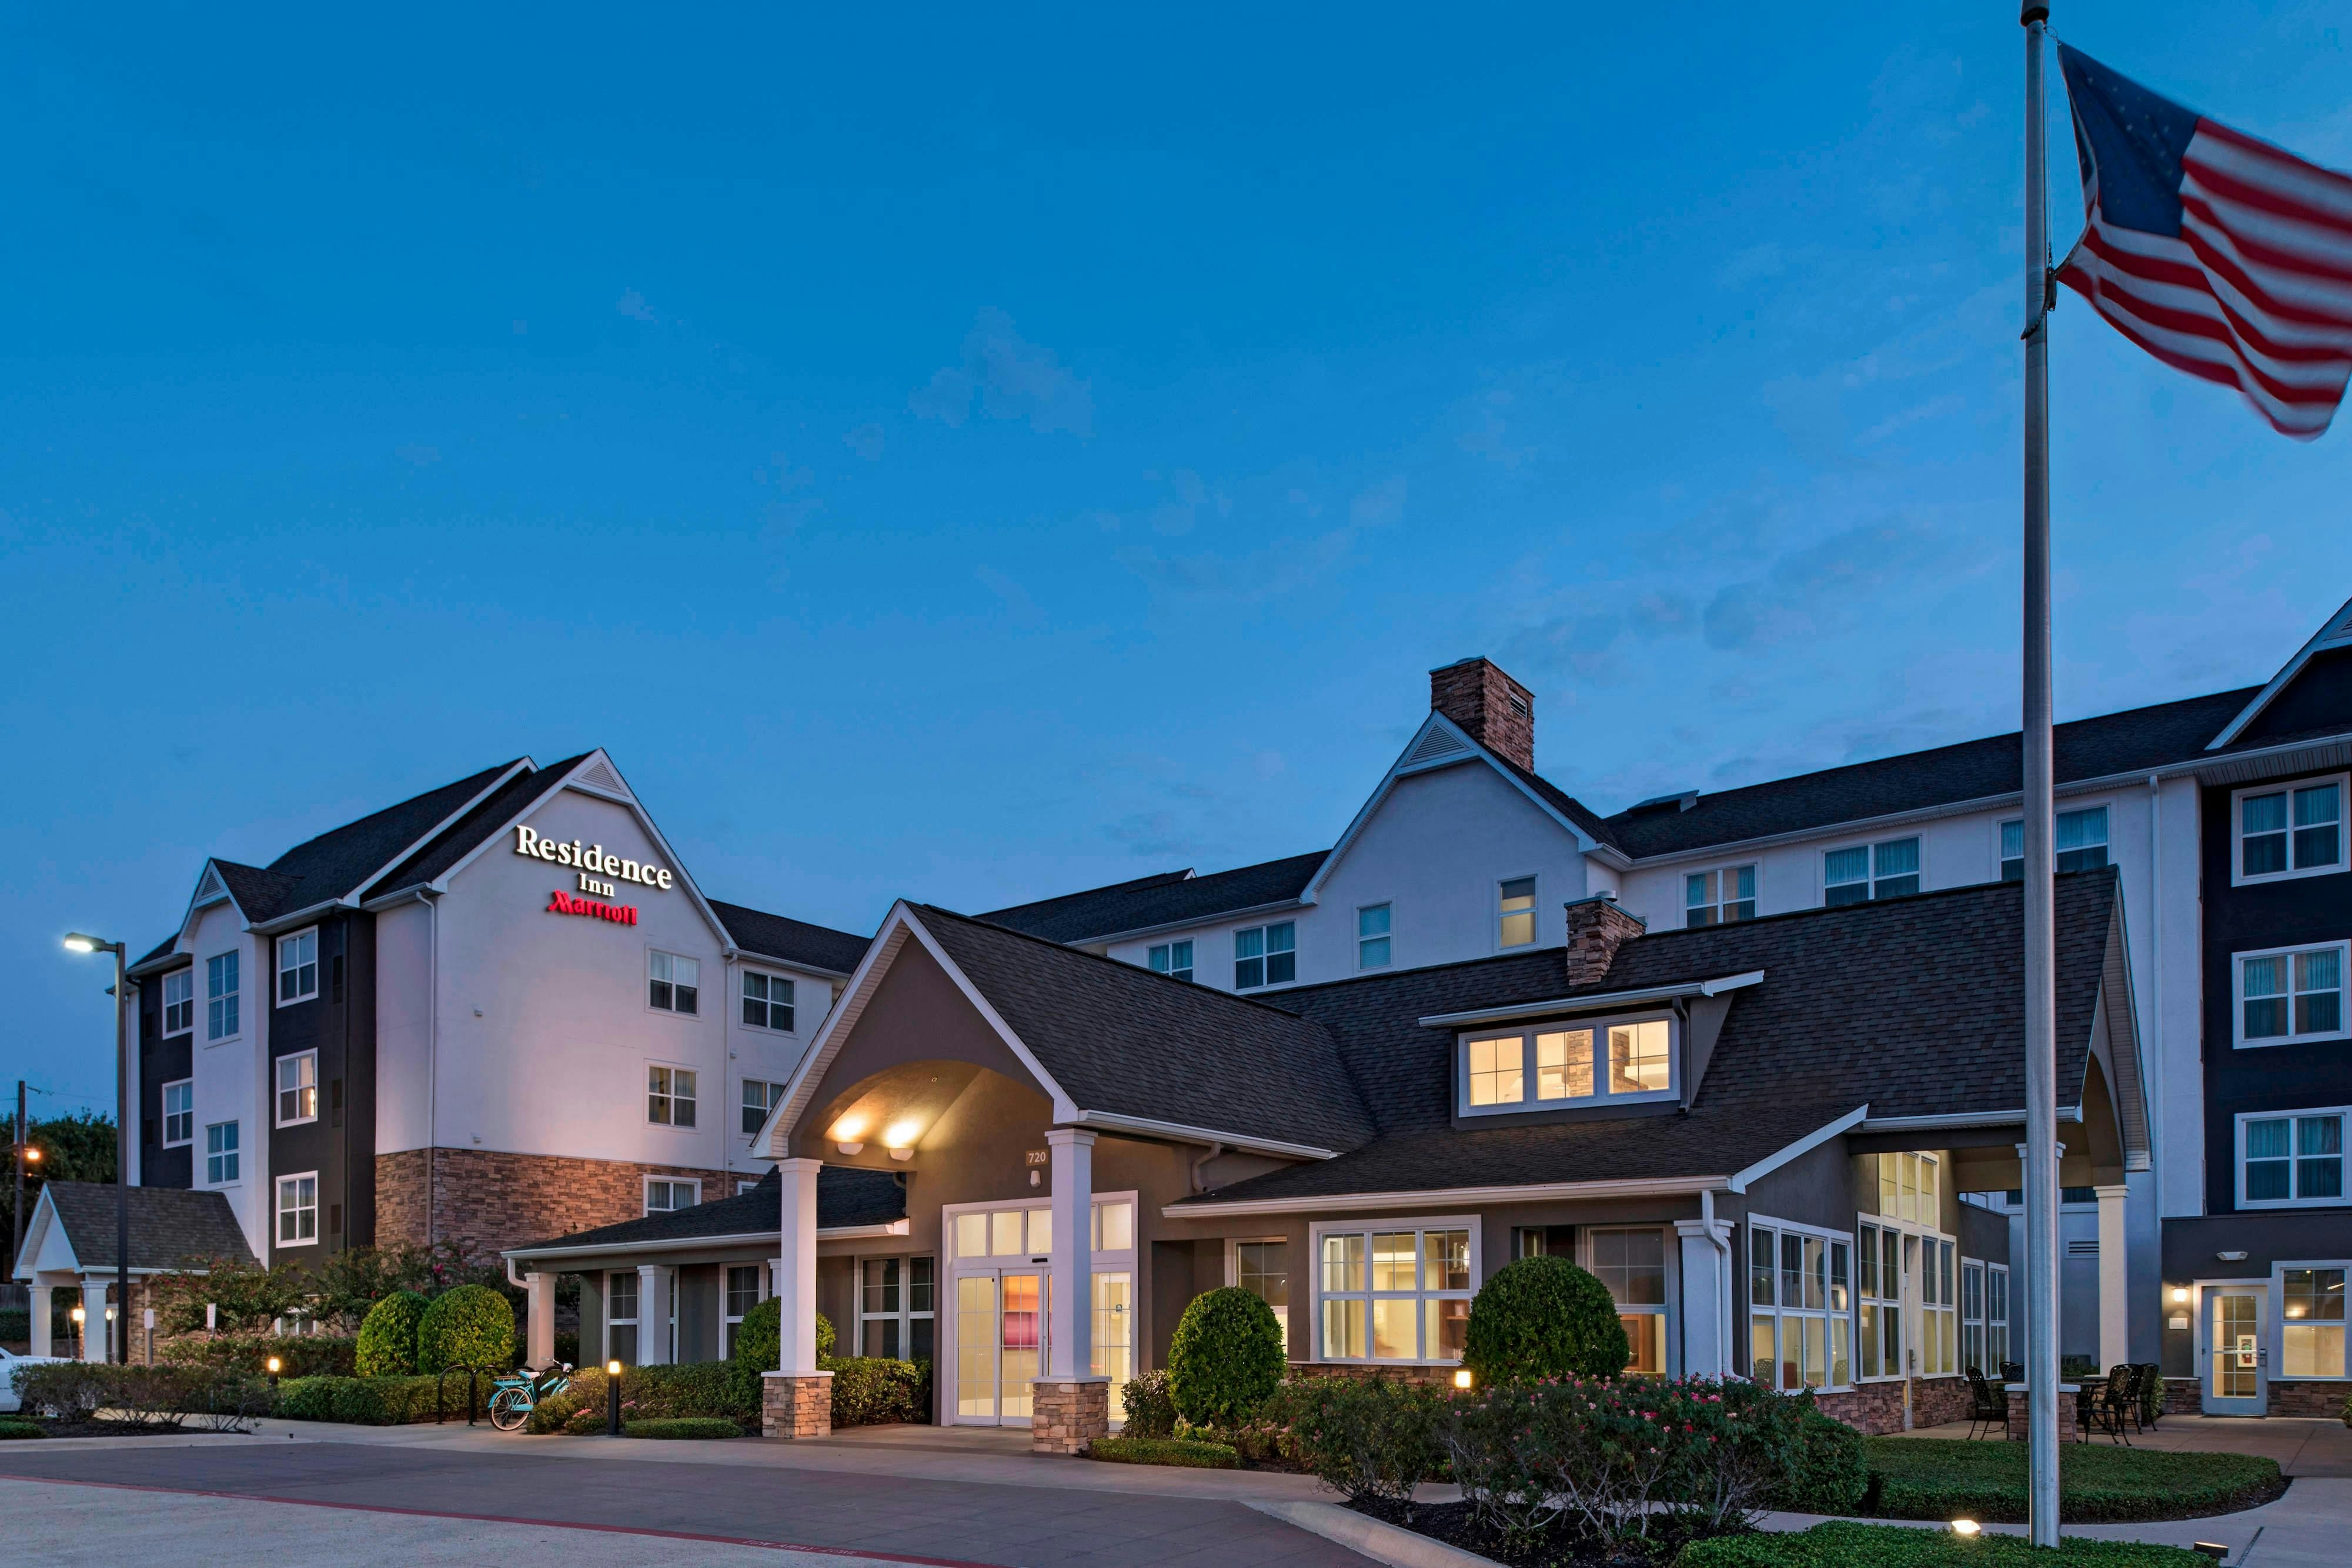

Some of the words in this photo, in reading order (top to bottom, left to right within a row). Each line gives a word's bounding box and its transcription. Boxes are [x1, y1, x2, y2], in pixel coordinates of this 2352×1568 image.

[516, 824, 671, 890] Residence
[579, 872, 615, 897] Inn
[547, 889, 638, 926] Marriott
[1028, 1152, 1046, 1164] 720
